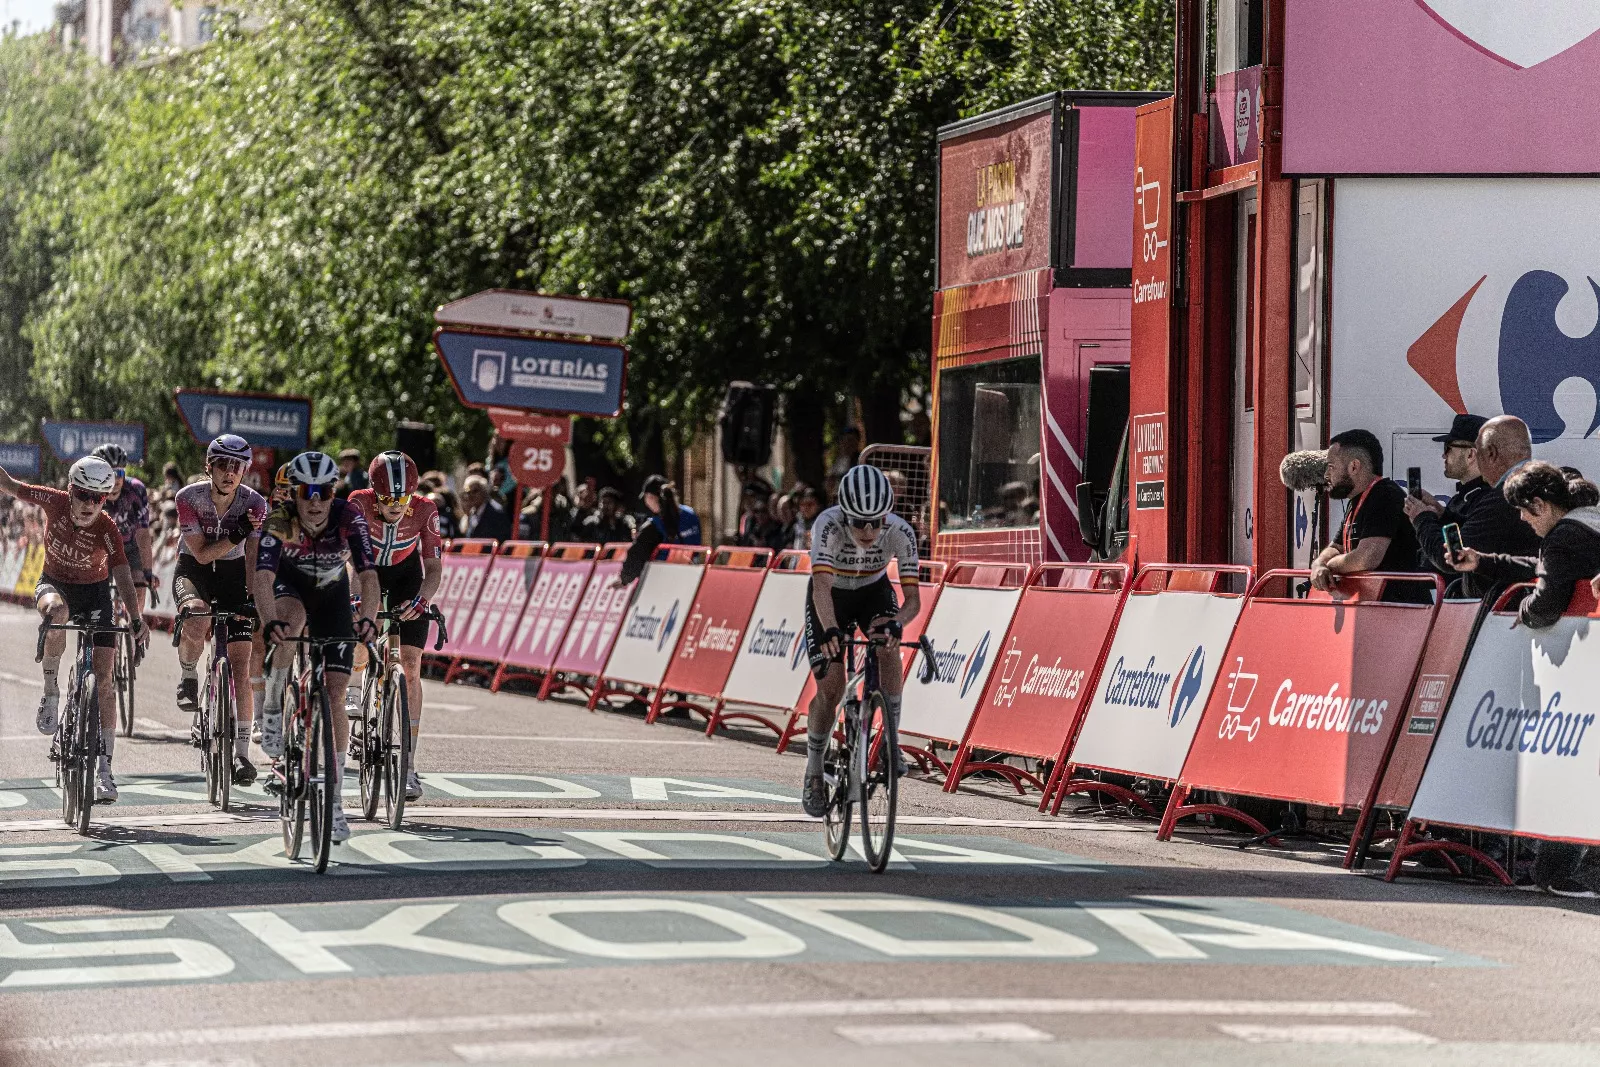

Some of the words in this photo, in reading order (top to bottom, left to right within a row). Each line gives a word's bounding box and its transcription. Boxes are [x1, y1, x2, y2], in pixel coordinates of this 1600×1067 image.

[967, 210, 985, 255] QUE
[986, 206, 1005, 251] NOS
[1006, 201, 1024, 247] UNE
[1134, 275, 1167, 304] Carrefour.
[511, 355, 609, 379] LOTERÍAS
[523, 447, 553, 472] 25
[30, 490, 53, 503] FENIX
[835, 553, 885, 565] LABORAL
[748, 618, 796, 658] Carrefour
[1020, 653, 1085, 700] Carrefour.es
[1104, 655, 1171, 709] Carrefour
[1268, 678, 1389, 735] Carrefour.es
[1466, 690, 1595, 757] Carrefour
